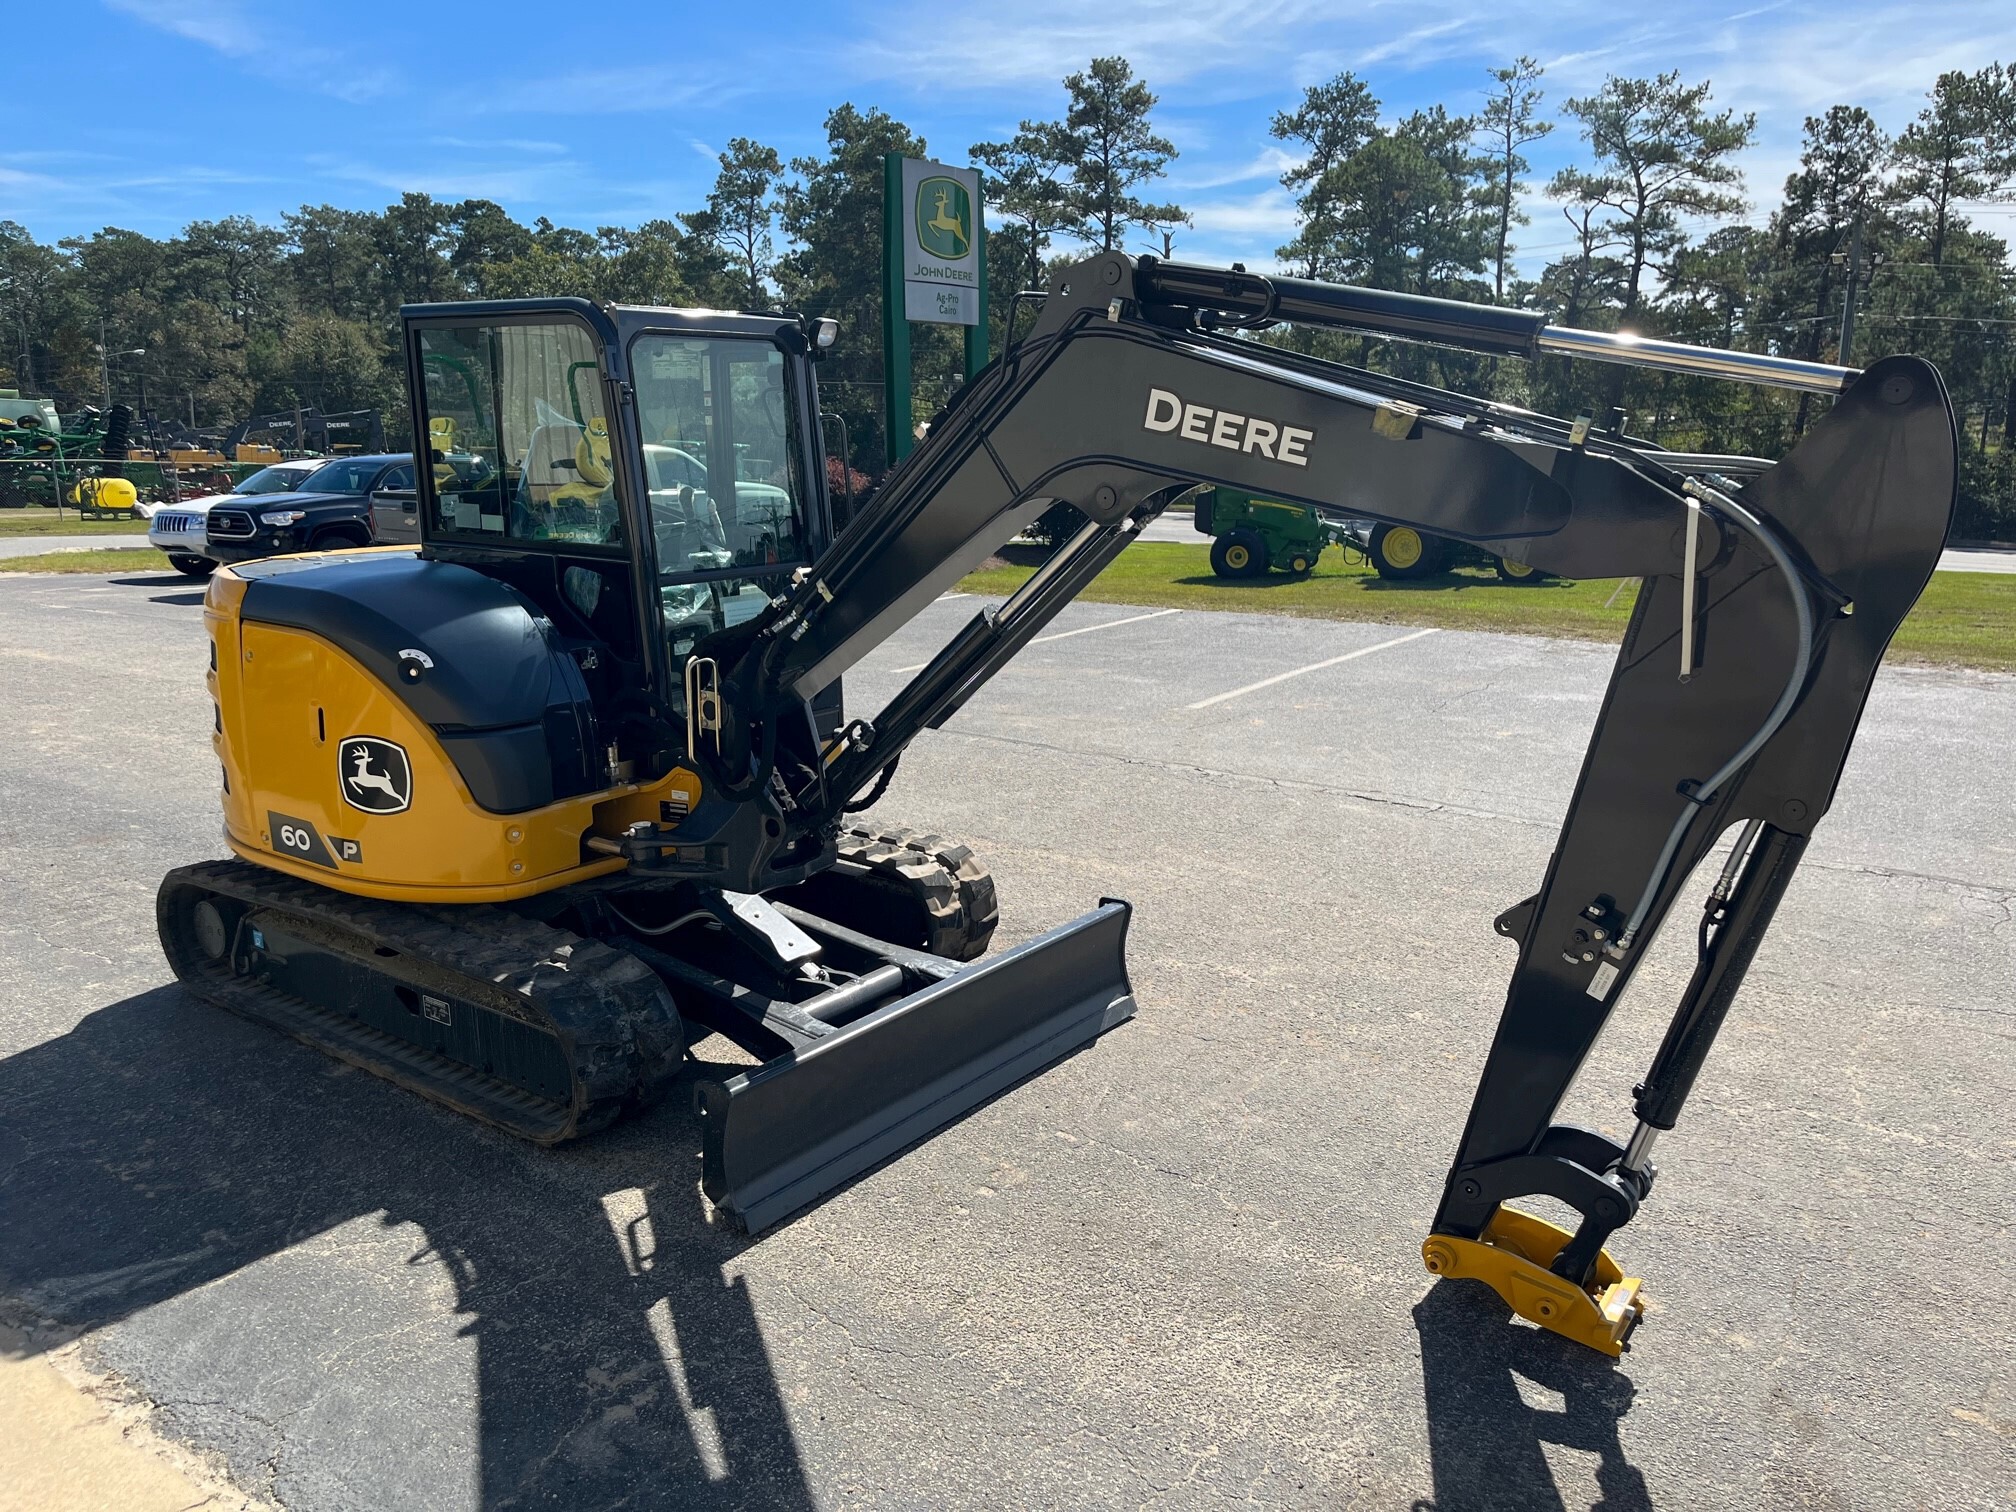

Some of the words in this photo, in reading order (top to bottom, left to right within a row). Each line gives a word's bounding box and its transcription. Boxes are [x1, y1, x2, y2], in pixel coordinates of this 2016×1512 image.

[914, 264, 943, 278] JOHN
[945, 267, 973, 281] DEERE
[939, 305, 957, 315] Cairo
[269, 420, 292, 428] DEERE
[1144, 388, 1313, 466] DEERE
[281, 824, 310, 851] 60
[343, 841, 357, 858] P
